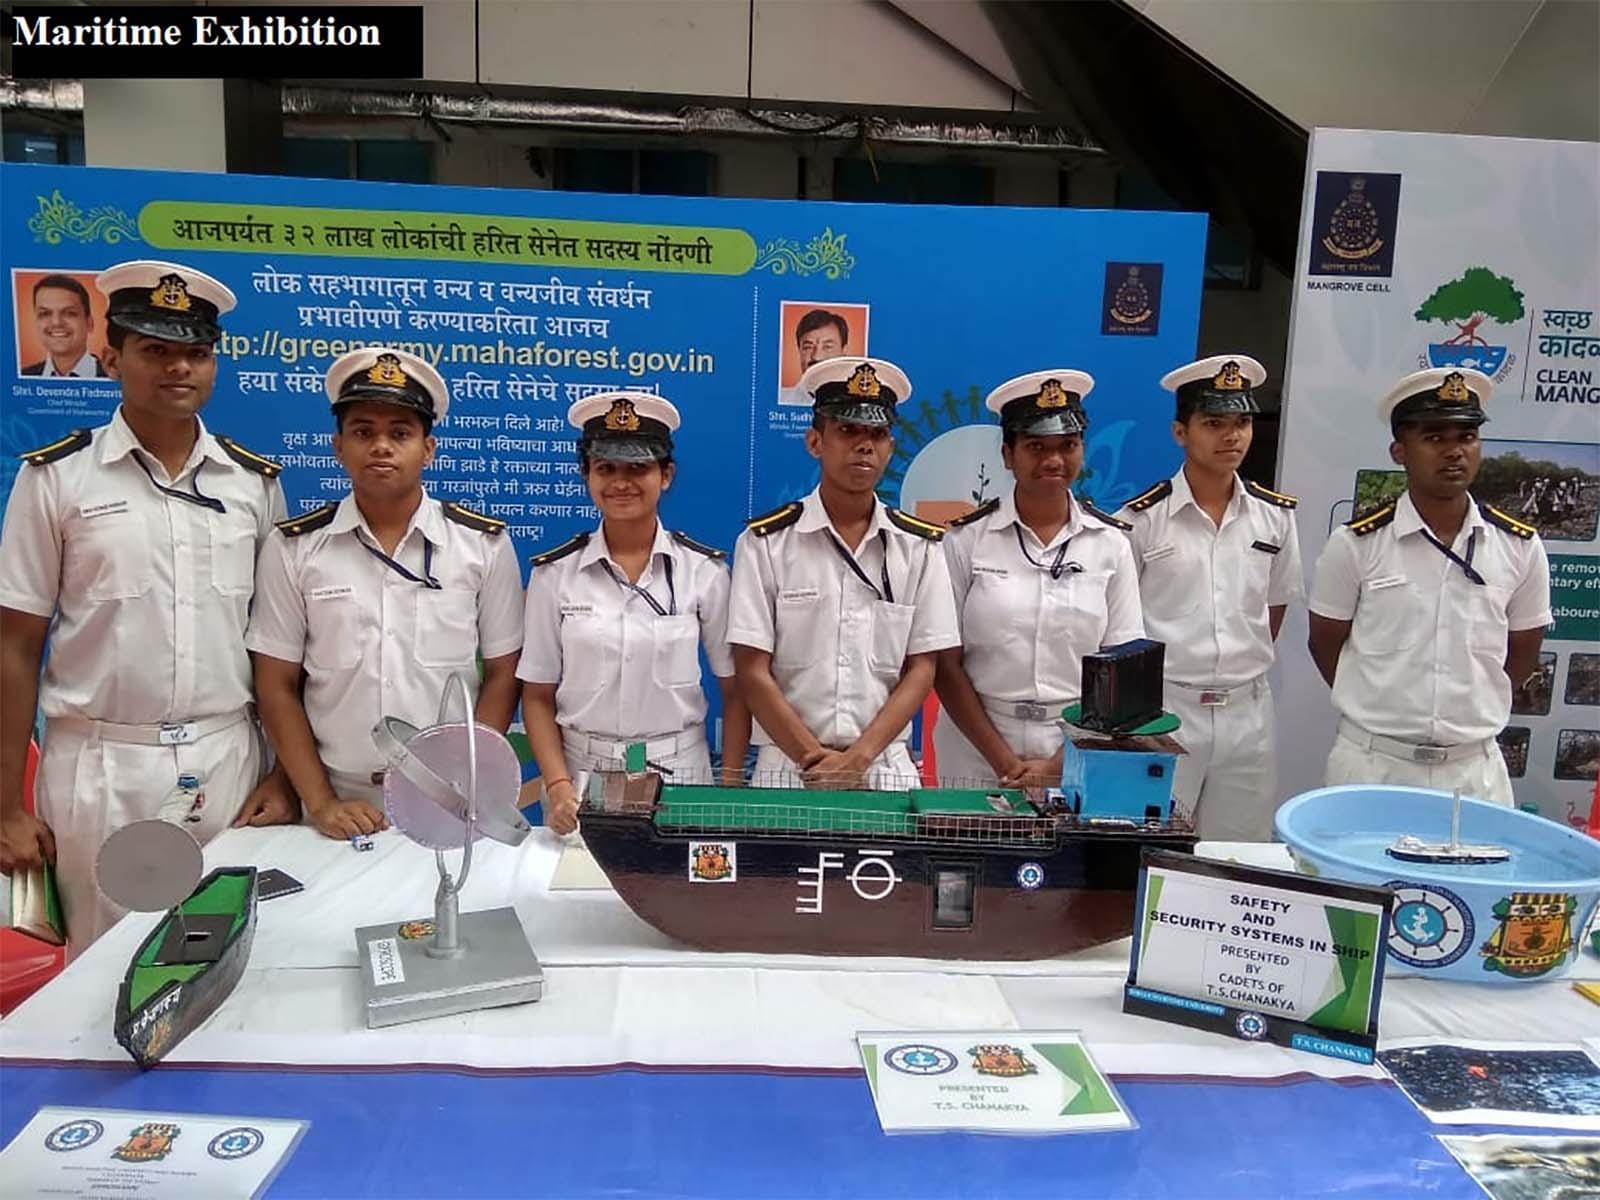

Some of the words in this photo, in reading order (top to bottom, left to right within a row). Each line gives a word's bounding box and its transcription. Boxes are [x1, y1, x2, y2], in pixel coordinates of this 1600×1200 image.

[324, 226, 375, 248] लाख
[381, 219, 466, 252] लोकांची
[473, 225, 522, 257] हरित
[528, 227, 579, 259] सेनेत
[586, 238, 641, 262] सदस्य
[647, 234, 714, 265] नोंदणी
[252, 264, 302, 294] लोक
[308, 272, 427, 307] सहभागातून
[433, 278, 473, 301] वन्य
[479, 281, 495, 302] व
[501, 276, 581, 307] वन्यजीव
[586, 280, 652, 310] संवर्धन
[1307, 280, 1364, 292] MANGROVE
[1366, 282, 1392, 293] CELL
[297, 301, 402, 330] प्रभावीपणे
[409, 307, 539, 336] करण्याकरिता
[544, 316, 610, 340] आजच
[284, 366, 328, 395] संके
[452, 371, 501, 402] हरित
[506, 373, 560, 402] सेनेचे
[1536, 368, 1592, 385] CLEAN
[1535, 384, 1600, 404] MANG
[1551, 605, 1600, 618] aboure
[1230, 894, 1292, 914] SAFETY
[1242, 912, 1276, 927] AND
[1150, 910, 1227, 933] SECURITY
[1231, 924, 1304, 949] SYSTEMS
[1309, 938, 1327, 953] IN
[1332, 943, 1370, 961] SHIP
[1220, 944, 1290, 966] PRESENTED
[1245, 963, 1262, 975] BY
[1219, 973, 1266, 993] CADETS
[1268, 981, 1286, 994] OF
[1206, 984, 1296, 1012] T.S.CHANAKYA
